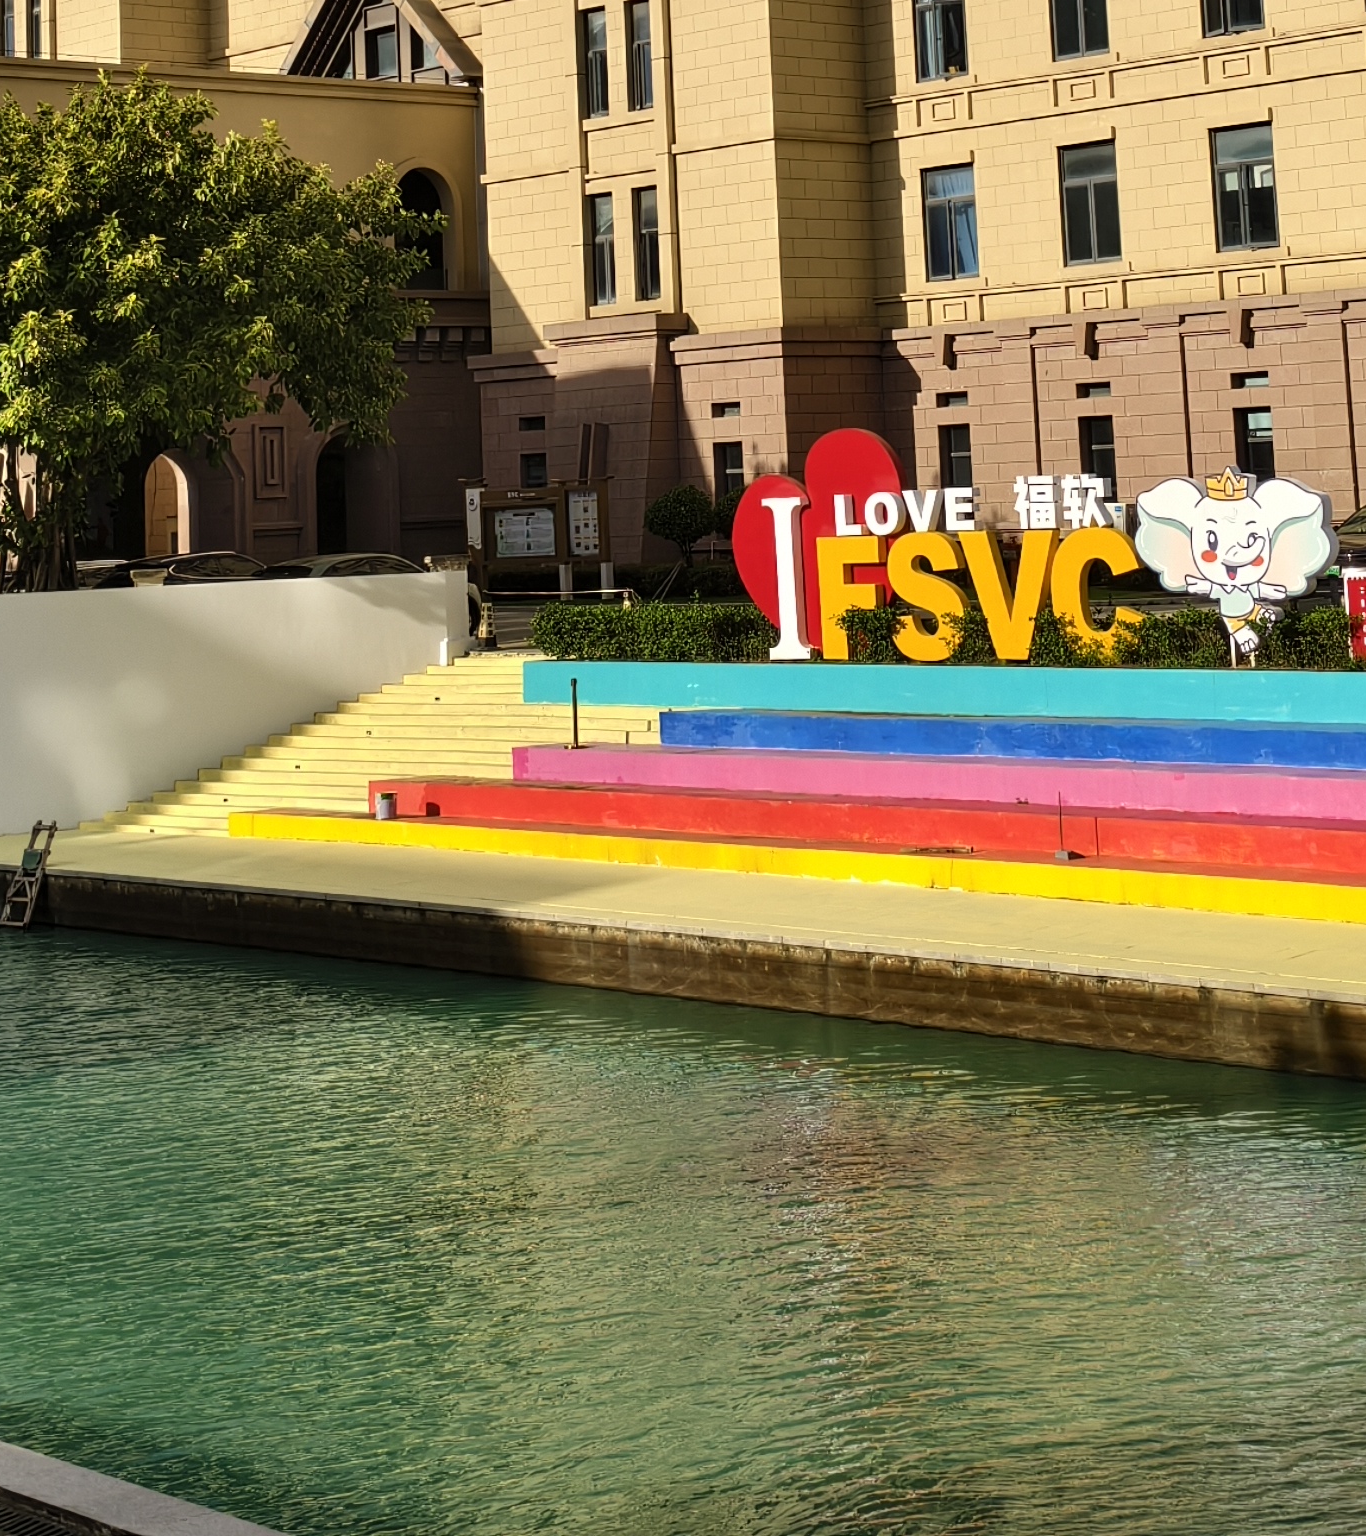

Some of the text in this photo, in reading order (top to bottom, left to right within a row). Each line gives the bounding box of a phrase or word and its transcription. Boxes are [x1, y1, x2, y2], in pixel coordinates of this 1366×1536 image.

[833, 474, 1110, 536] LOVE 福软
[761, 496, 811, 661] I
[815, 528, 1143, 663] FSVC
